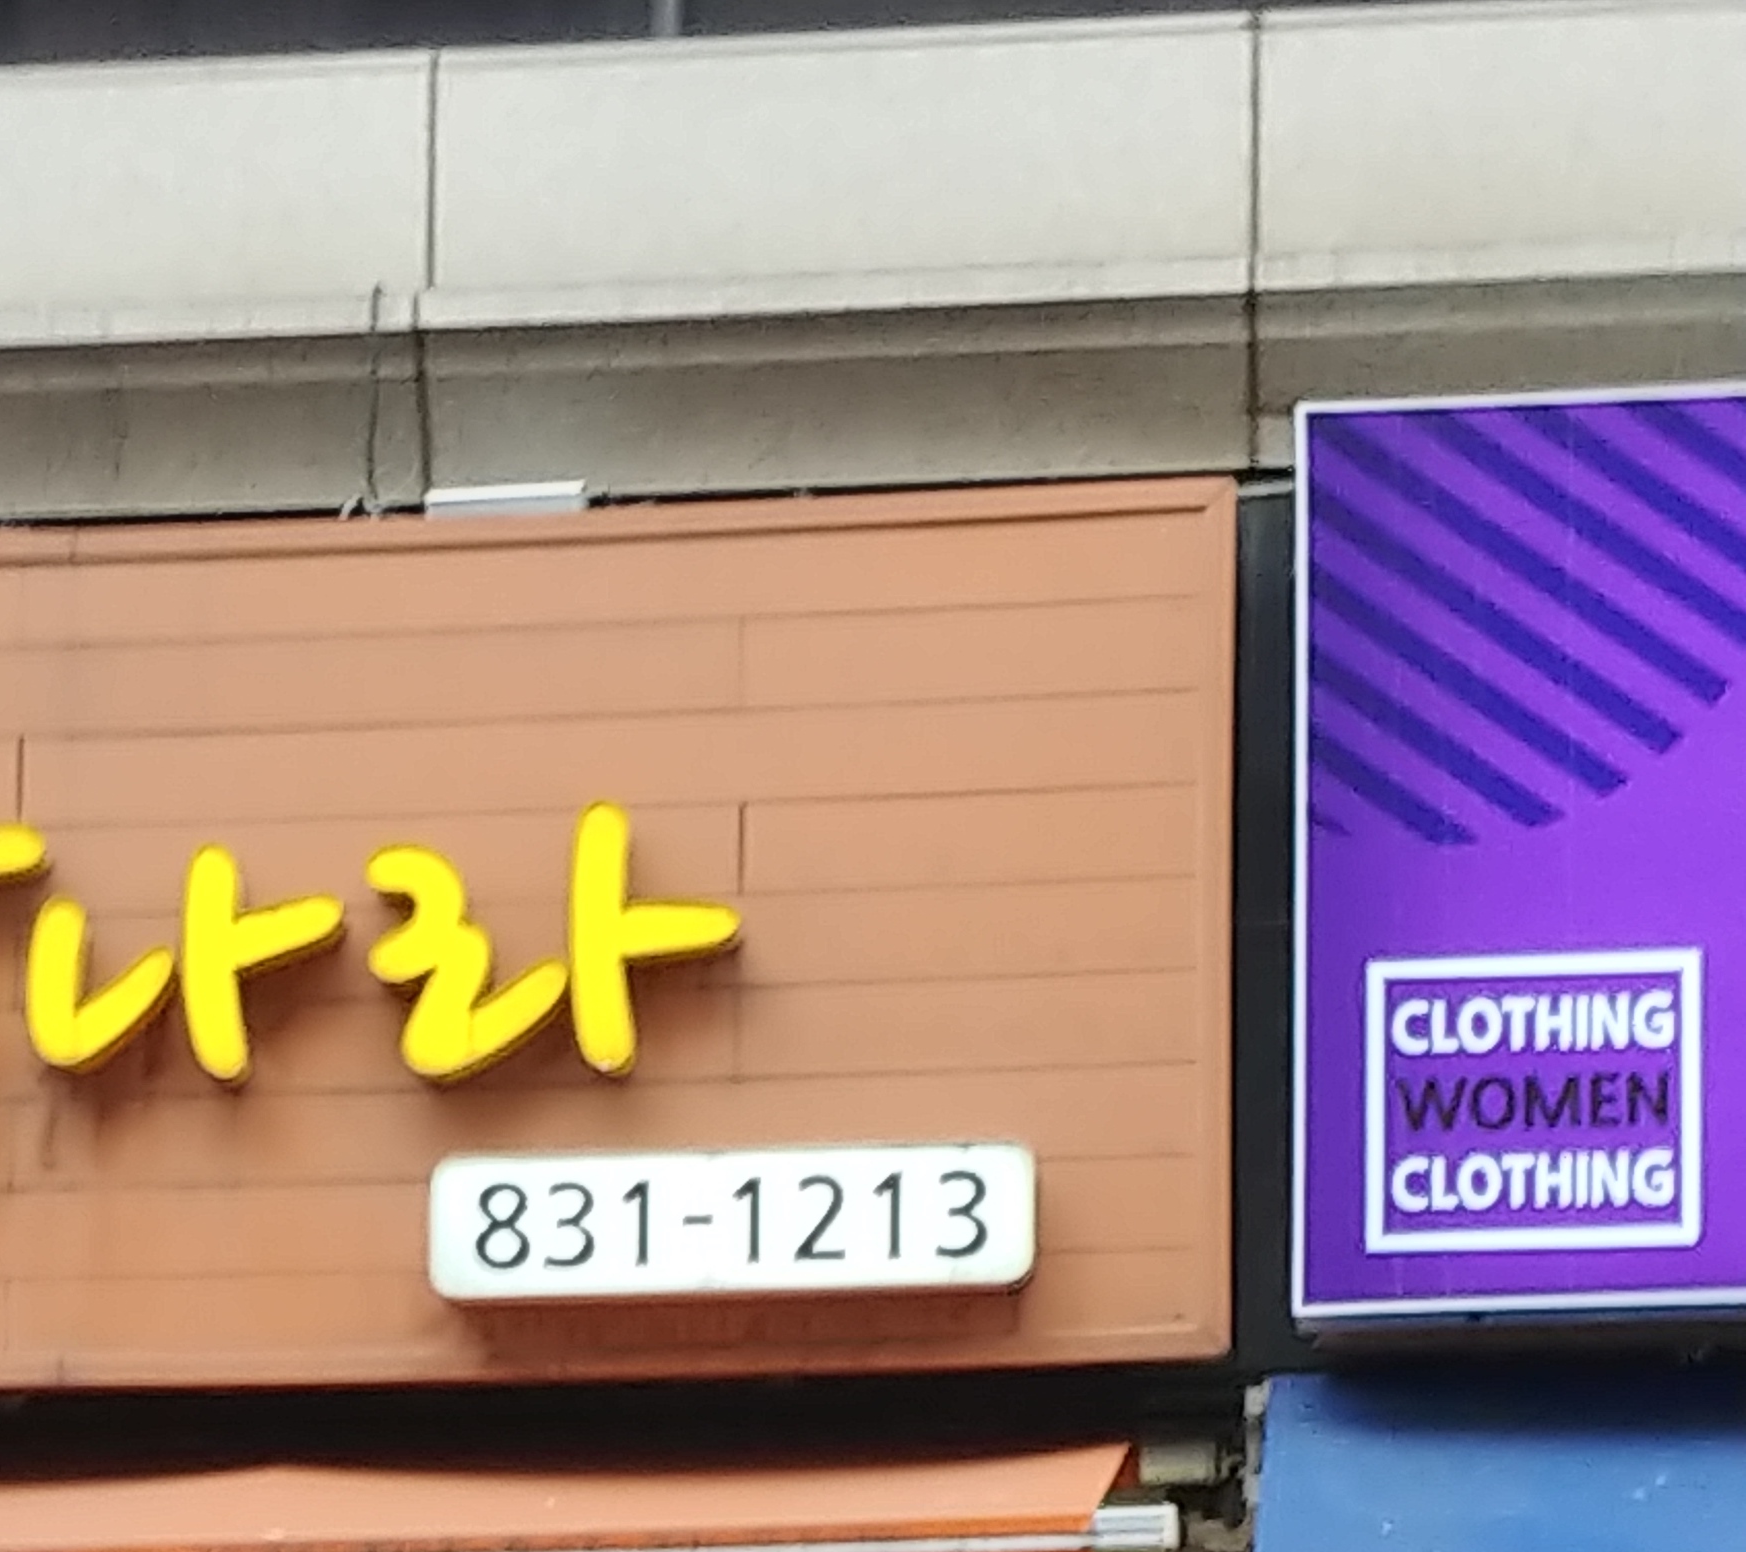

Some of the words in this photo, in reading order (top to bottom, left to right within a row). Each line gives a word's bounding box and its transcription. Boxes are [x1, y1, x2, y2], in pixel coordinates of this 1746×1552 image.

[1391, 991, 1676, 1055] CLOTHING
[1396, 1071, 1671, 1132] WOMEN
[1391, 1148, 1676, 1214] CLOTHING
[474, 1168, 992, 1271] 831-1213
